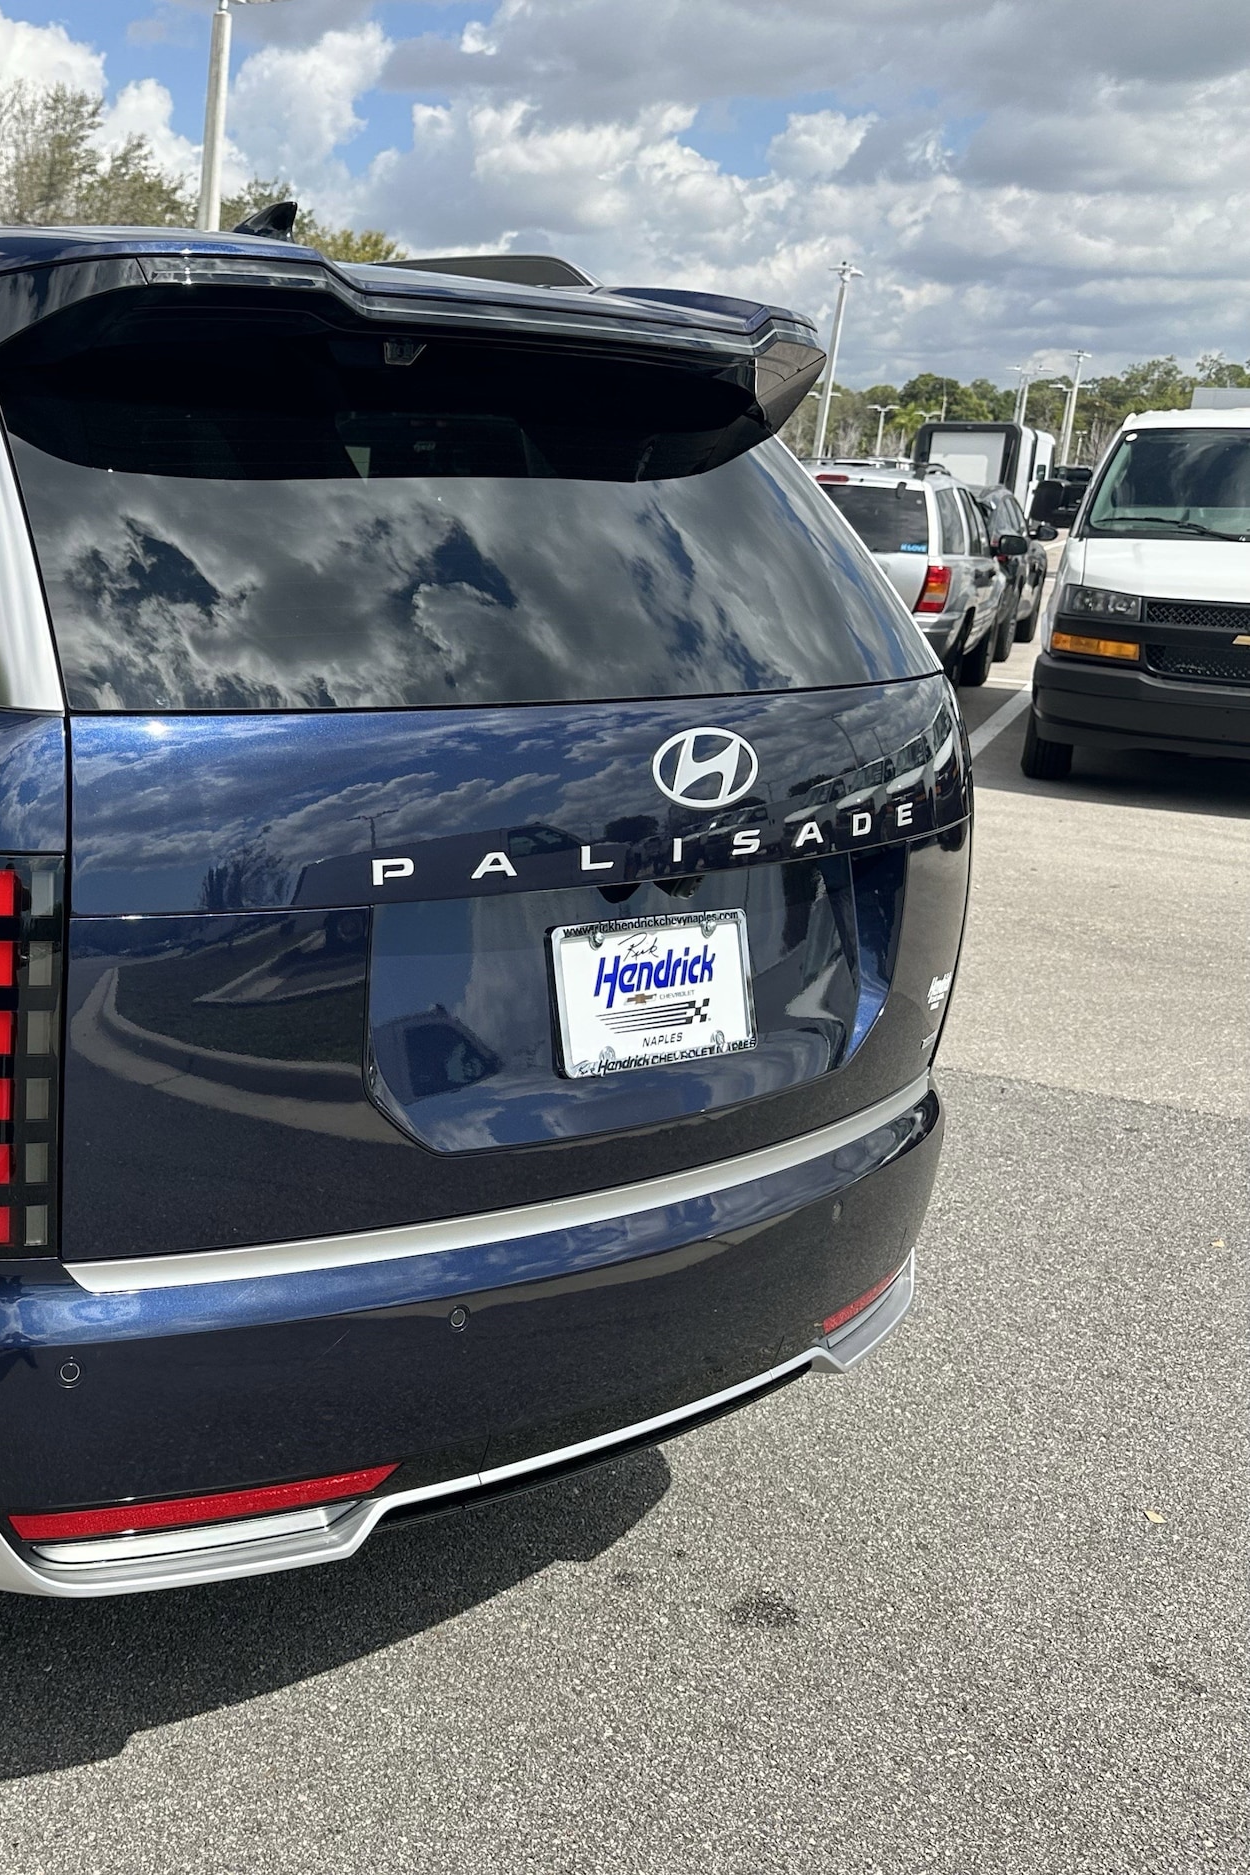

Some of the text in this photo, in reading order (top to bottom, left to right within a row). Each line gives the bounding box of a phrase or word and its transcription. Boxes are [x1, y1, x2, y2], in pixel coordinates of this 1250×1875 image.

[372, 803, 914, 886] PALISADE
[593, 945, 716, 1008] Hendrick
[659, 990, 695, 1000] CHEVROLET
[642, 1032, 684, 1047] NAPLES
[598, 1054, 650, 1076] Hendrick
[651, 1046, 715, 1065] CHEVROLET
